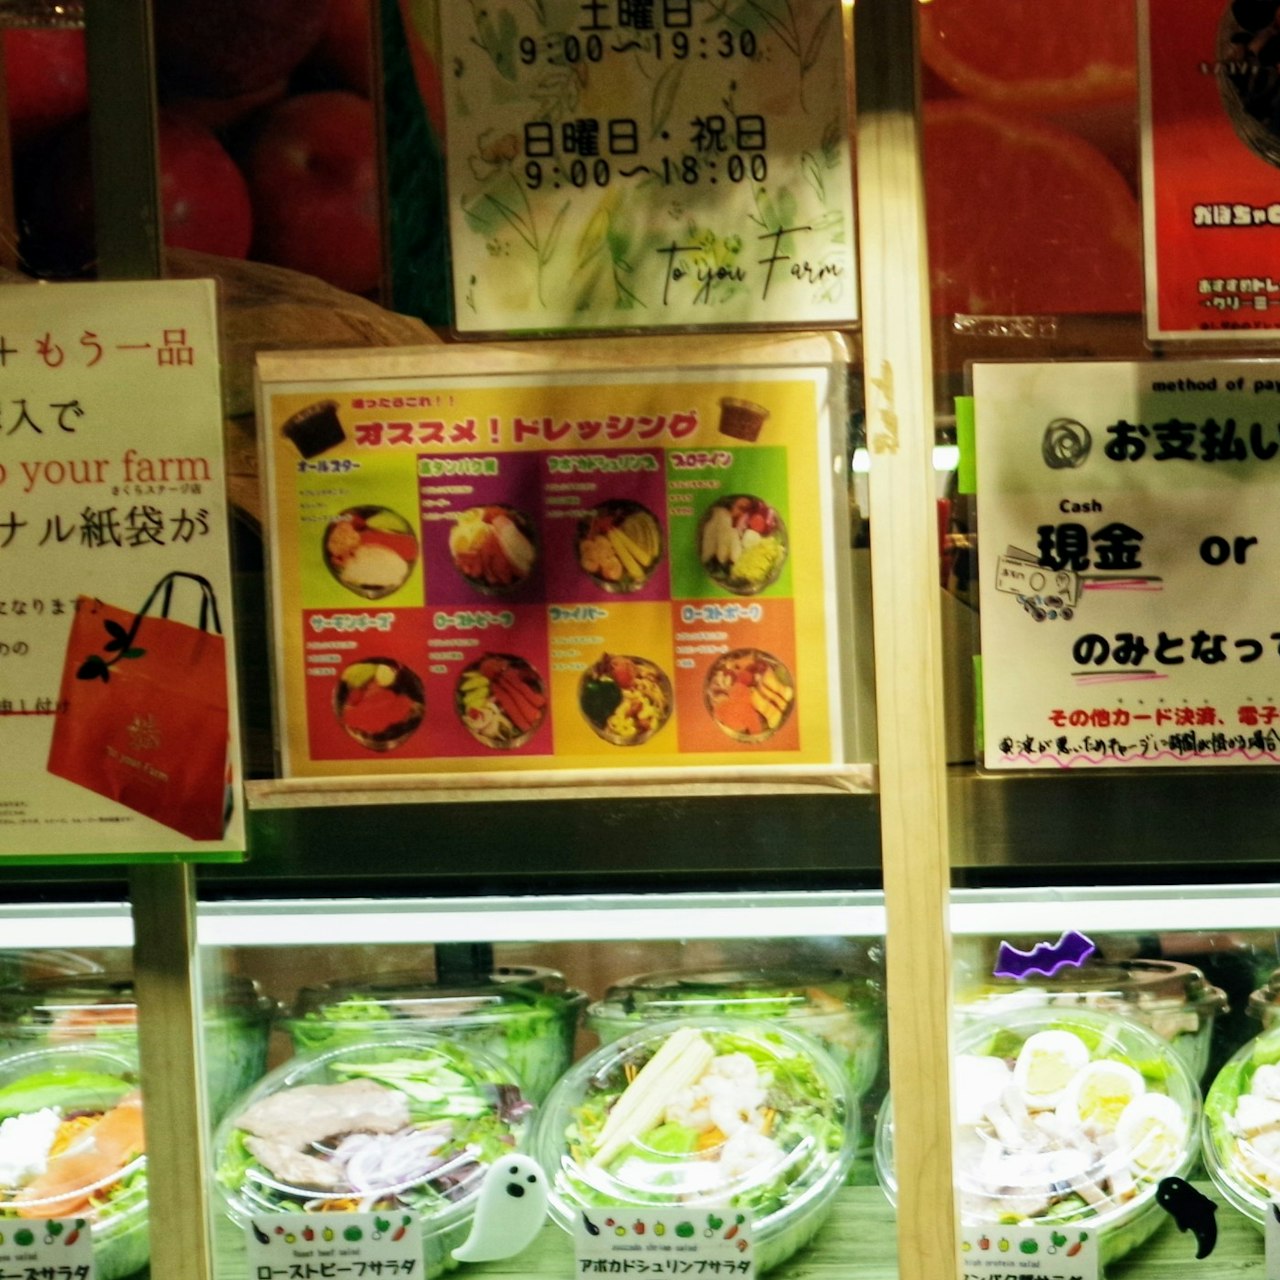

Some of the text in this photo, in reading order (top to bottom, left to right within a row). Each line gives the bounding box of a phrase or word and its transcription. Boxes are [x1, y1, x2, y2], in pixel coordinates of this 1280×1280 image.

[579, 0, 693, 31] 土曜日
[524, 115, 768, 158] 日曜日・祝日
[657, 225, 843, 306] To you Farm
[1151, 377, 1218, 393] method
[1225, 376, 1246, 393] of
[0, 398, 85, 436] 入で
[20, 458, 110, 493] your
[122, 449, 212, 484] farm
[1058, 498, 1103, 514] Cash
[1035, 520, 1146, 573] 現金
[1199, 532, 1259, 567] or
[257, 1258, 416, 1280] ローストビーフサラダ
[579, 1258, 752, 1275] アボカドシュリンプサラダ
